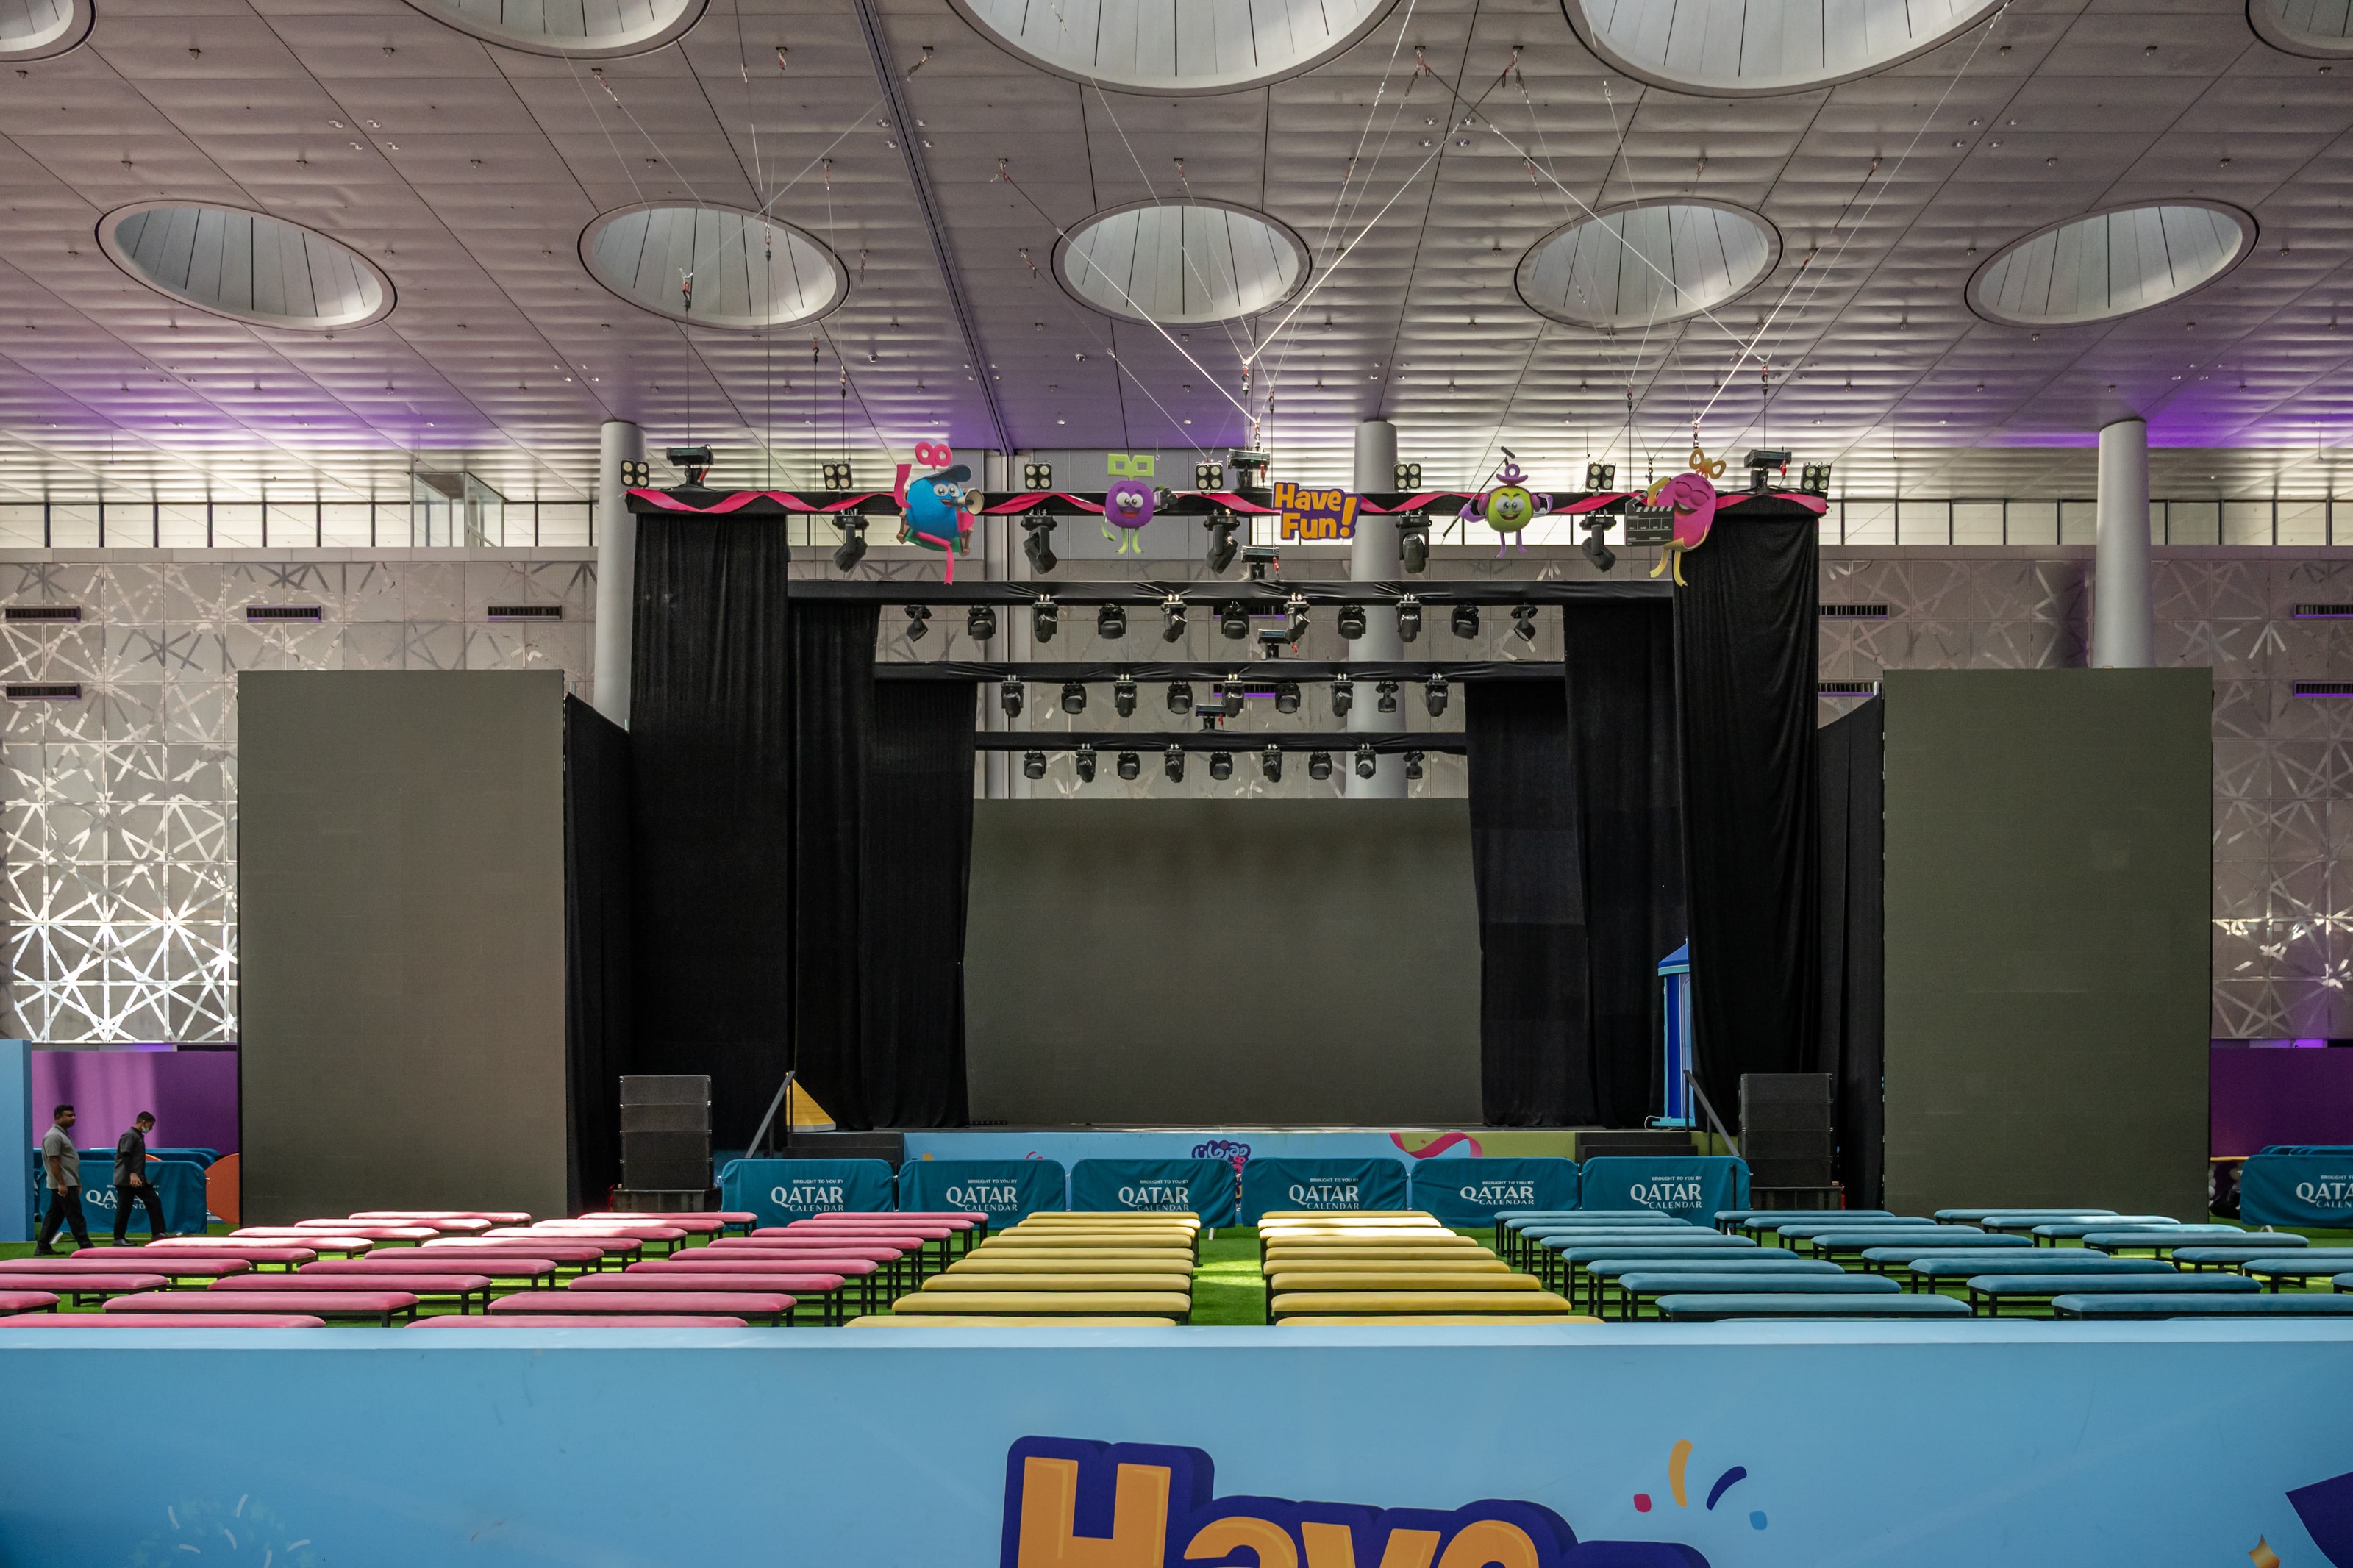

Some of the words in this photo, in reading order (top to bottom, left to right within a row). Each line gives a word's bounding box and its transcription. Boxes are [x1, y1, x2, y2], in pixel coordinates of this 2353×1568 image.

[1274, 483, 1342, 511] Have
[1282, 496, 1357, 538] Fun!
[771, 1186, 843, 1208] QATAR
[946, 1186, 1018, 1207] QATAR
[1118, 1186, 1189, 1207] QATAR
[1288, 1184, 1359, 1206] QATAR
[1460, 1186, 1535, 1202] QATAR
[1629, 1183, 1702, 1205] QATAR
[1649, 1200, 1702, 1209] CALENDAR
[790, 1204, 844, 1212] CALENDAR
[1307, 1202, 1359, 1210] CALENDAR
